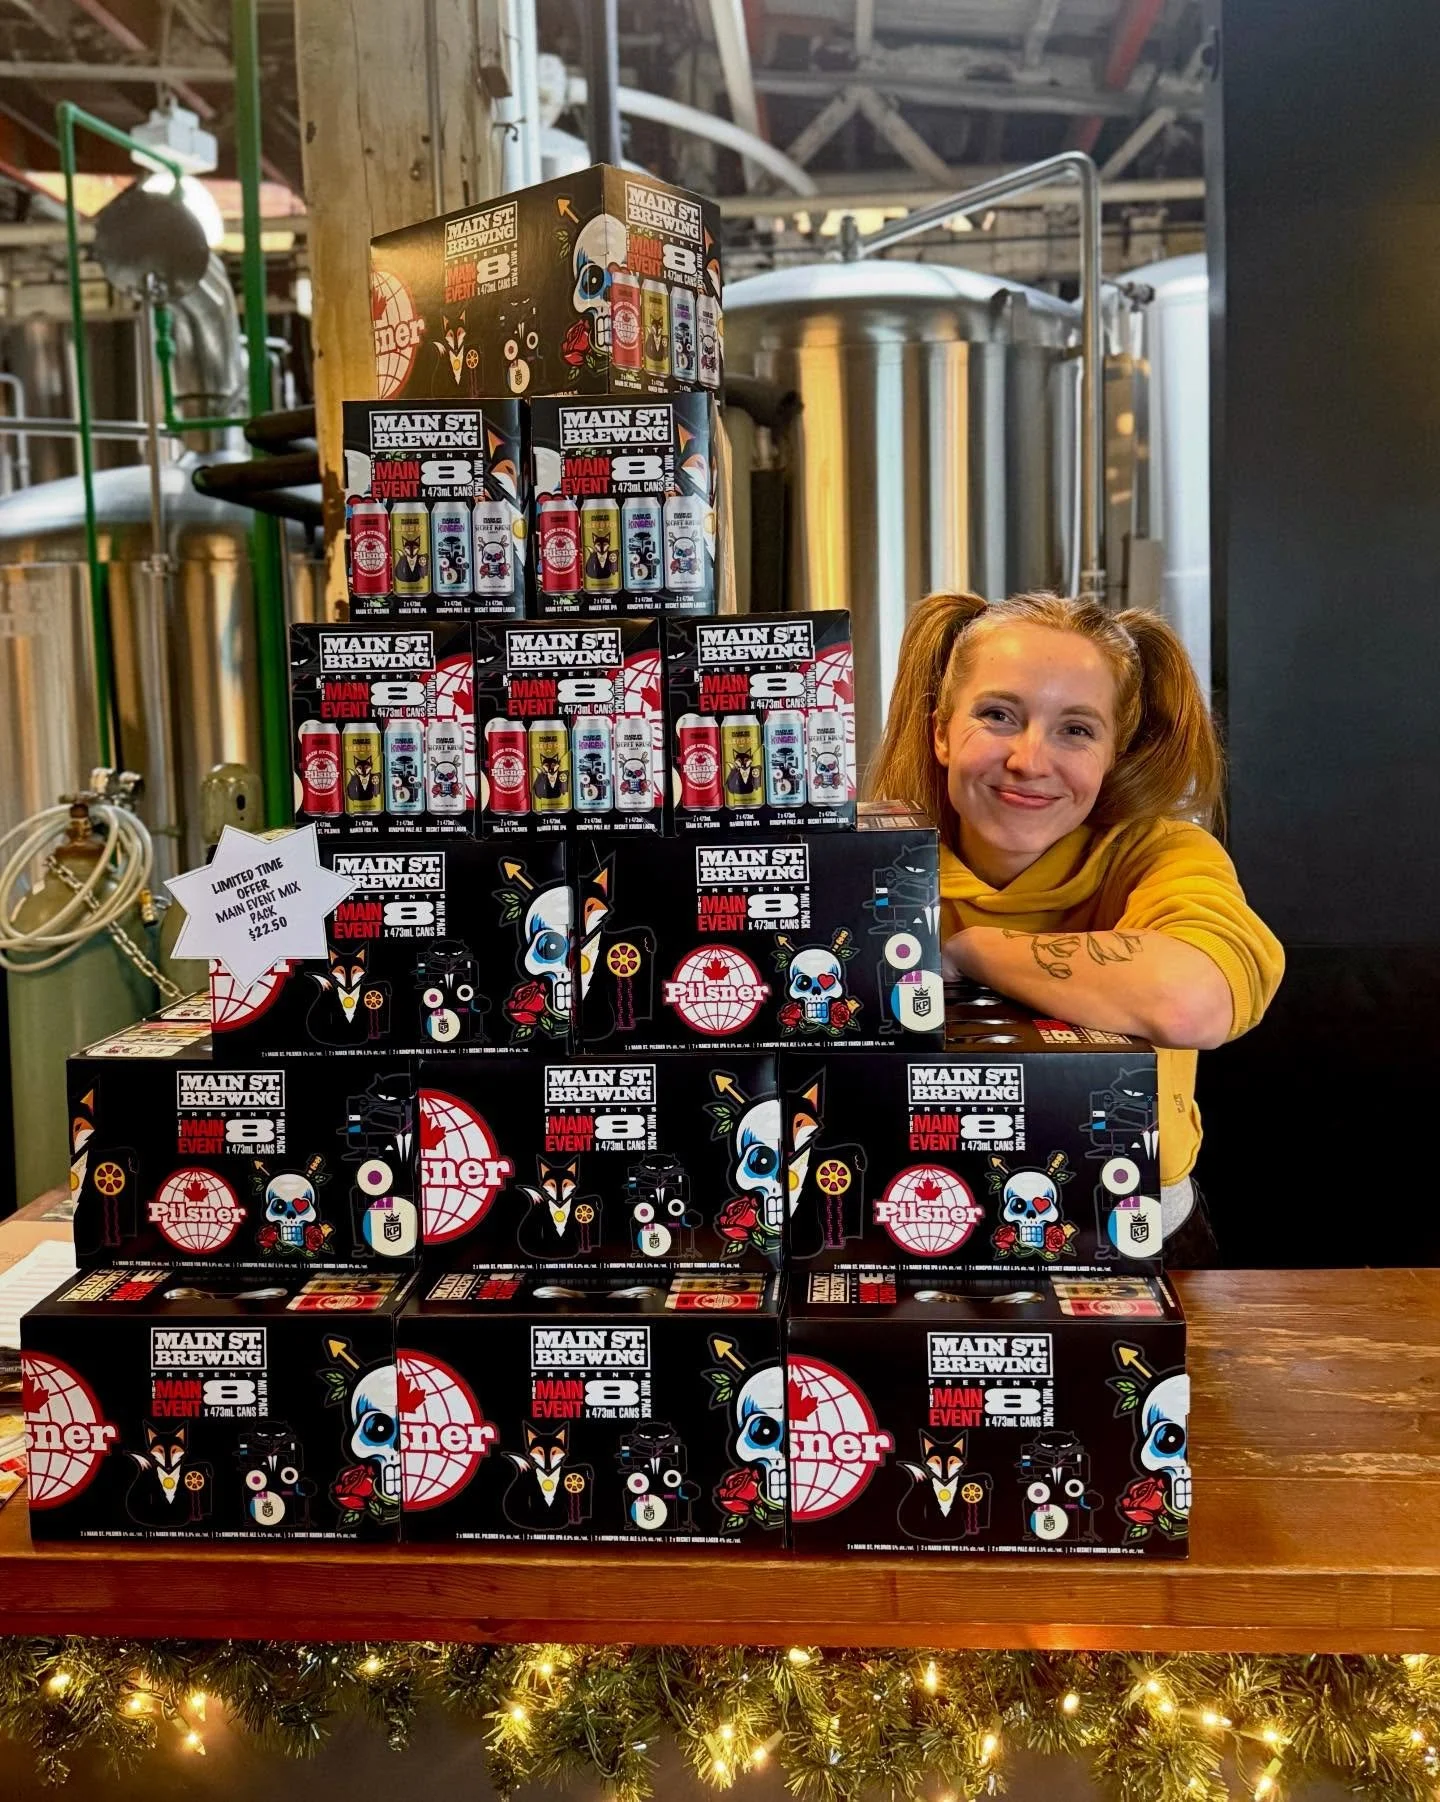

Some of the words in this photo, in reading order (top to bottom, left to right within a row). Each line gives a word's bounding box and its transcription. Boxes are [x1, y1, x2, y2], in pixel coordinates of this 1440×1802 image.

[628, 187, 675, 219] MAIN
[677, 203, 699, 226] ST.
[446, 213, 490, 241] MAIN
[492, 207, 514, 229] ST.
[628, 205, 699, 242] BREWING
[447, 223, 514, 256] BREWING
[629, 237, 660, 264] MAIN
[476, 253, 510, 285] 8
[626, 257, 660, 282] EVENT
[661, 246, 696, 280] 8
[447, 262, 475, 285] MAIN
[444, 280, 474, 303] EVENT
[373, 415, 441, 433] MAIN
[444, 414, 477, 432] ST.
[563, 410, 631, 429] MAIN
[635, 409, 668, 427] ST.
[374, 432, 477, 449] BREWING
[564, 426, 668, 445] BREWING
[376, 462, 419, 480] MAIN
[420, 461, 471, 486] 8
[565, 457, 609, 477] MAIN
[611, 455, 663, 482] 8
[372, 481, 419, 498] EVENT
[427, 487, 451, 498] 473mL
[452, 487, 472, 497] CANS
[561, 477, 610, 495] EVENT
[618, 482, 642, 493] 473mL
[643, 481, 663, 492] CANS
[323, 636, 392, 654] MAIN
[395, 636, 428, 653] ST.
[510, 634, 579, 651] MAIN
[582, 633, 616, 650] ST.
[701, 627, 770, 647] MAIN
[773, 626, 808, 644] ST.
[324, 653, 429, 669] BREWING
[511, 649, 616, 667] BREWING
[701, 642, 808, 662] BREWING
[326, 682, 370, 700] MAIN
[512, 679, 557, 697] MAIN
[559, 678, 612, 703] 8
[703, 674, 748, 693] MAIN
[750, 672, 804, 698] 8
[371, 681, 425, 706] 8
[699, 693, 749, 711] EVENT
[321, 701, 370, 718] EVENT
[508, 698, 557, 715] EVENT
[337, 857, 404, 873] MAIN
[408, 857, 440, 873] ST.
[700, 849, 767, 867] MAIN
[771, 848, 803, 866] ST.
[211, 869, 254, 894] LIMITED
[255, 857, 284, 876] TIME
[700, 865, 803, 882] BREWING
[236, 879, 270, 899] OFFER
[696, 885, 809, 894] PRESENTS
[215, 903, 246, 923] MAIN
[246, 890, 276, 911] EVENT
[278, 881, 302, 898] MIX
[702, 895, 745, 913] MAIN
[747, 894, 799, 918] 8
[799, 894, 810, 908] MIX
[250, 905, 277, 924] PACK
[338, 902, 382, 920] MAIN
[384, 901, 434, 926] 8
[800, 910, 810, 928] PACK
[248, 916, 288, 941] $22.50
[334, 921, 382, 937] EVENT
[390, 926, 414, 937] 473mL
[415, 926, 434, 937] CANS
[697, 914, 745, 931] EVENT
[754, 919, 778, 930] 473mL
[779, 918, 799, 929] CANS
[665, 982, 769, 1003] Pilsner
[180, 1075, 245, 1091] MAIN
[248, 1075, 280, 1091] ST.
[548, 1069, 615, 1087] MAIN
[619, 1069, 651, 1086] ST.
[911, 1069, 981, 1086] MAIN
[985, 1069, 1019, 1085] ST.
[180, 1091, 280, 1106] BREWING
[549, 1086, 651, 1102] BREWING
[912, 1086, 1019, 1101] BREWING
[545, 1106, 656, 1114] PRESENTS
[182, 1119, 223, 1136] MAIN
[225, 1119, 274, 1142] 8
[550, 1115, 592, 1133] MAIN
[594, 1115, 645, 1139] 8
[646, 1115, 656, 1129] MIX
[914, 1115, 958, 1133] MAIN
[960, 1115, 1013, 1139] 8
[1014, 1115, 1024, 1129] MIX
[177, 1138, 223, 1153] EVENT
[231, 1144, 254, 1154] 473mL
[256, 1144, 274, 1154] CANS
[545, 1135, 592, 1151] EVENT
[601, 1140, 624, 1151] 473mL
[626, 1140, 645, 1150] CANS
[646, 1132, 656, 1150] PACK
[909, 1134, 958, 1151] EVENT
[967, 1140, 992, 1151] 473mL
[993, 1140, 1013, 1150] CANS
[1014, 1132, 1025, 1150] PACK
[148, 1202, 246, 1222] Pilsner
[876, 1202, 983, 1223] Pilsner
[155, 1332, 224, 1349] MAIN
[228, 1332, 261, 1349] ST.
[535, 1331, 606, 1349] MAIN
[610, 1331, 645, 1349] ST.
[932, 1337, 1007, 1356] MAIN
[1011, 1338, 1047, 1356] ST.
[155, 1350, 261, 1365] BREWING
[535, 1349, 645, 1365] BREWING
[932, 1356, 1047, 1373] BREWING
[156, 1379, 201, 1397] MAIN
[203, 1379, 256, 1404] 8
[537, 1380, 583, 1398] MAIN
[585, 1380, 639, 1406] 8
[640, 1380, 651, 1395] MIX
[1042, 1389, 1053, 1404] MIX
[934, 1388, 982, 1407] MAIN
[984, 1388, 1041, 1414] 8
[151, 1399, 201, 1416] EVENT
[210, 1406, 234, 1416] 473mL
[236, 1406, 256, 1416] CANS
[532, 1401, 583, 1417] EVENT
[592, 1407, 617, 1418] 473mL
[618, 1407, 639, 1418] CANS
[640, 1398, 651, 1417] PACK
[1042, 1407, 1054, 1426] PACK
[929, 1409, 982, 1426] EVENT
[992, 1415, 1018, 1427] 473mL
[1019, 1415, 1041, 1427] CANS
